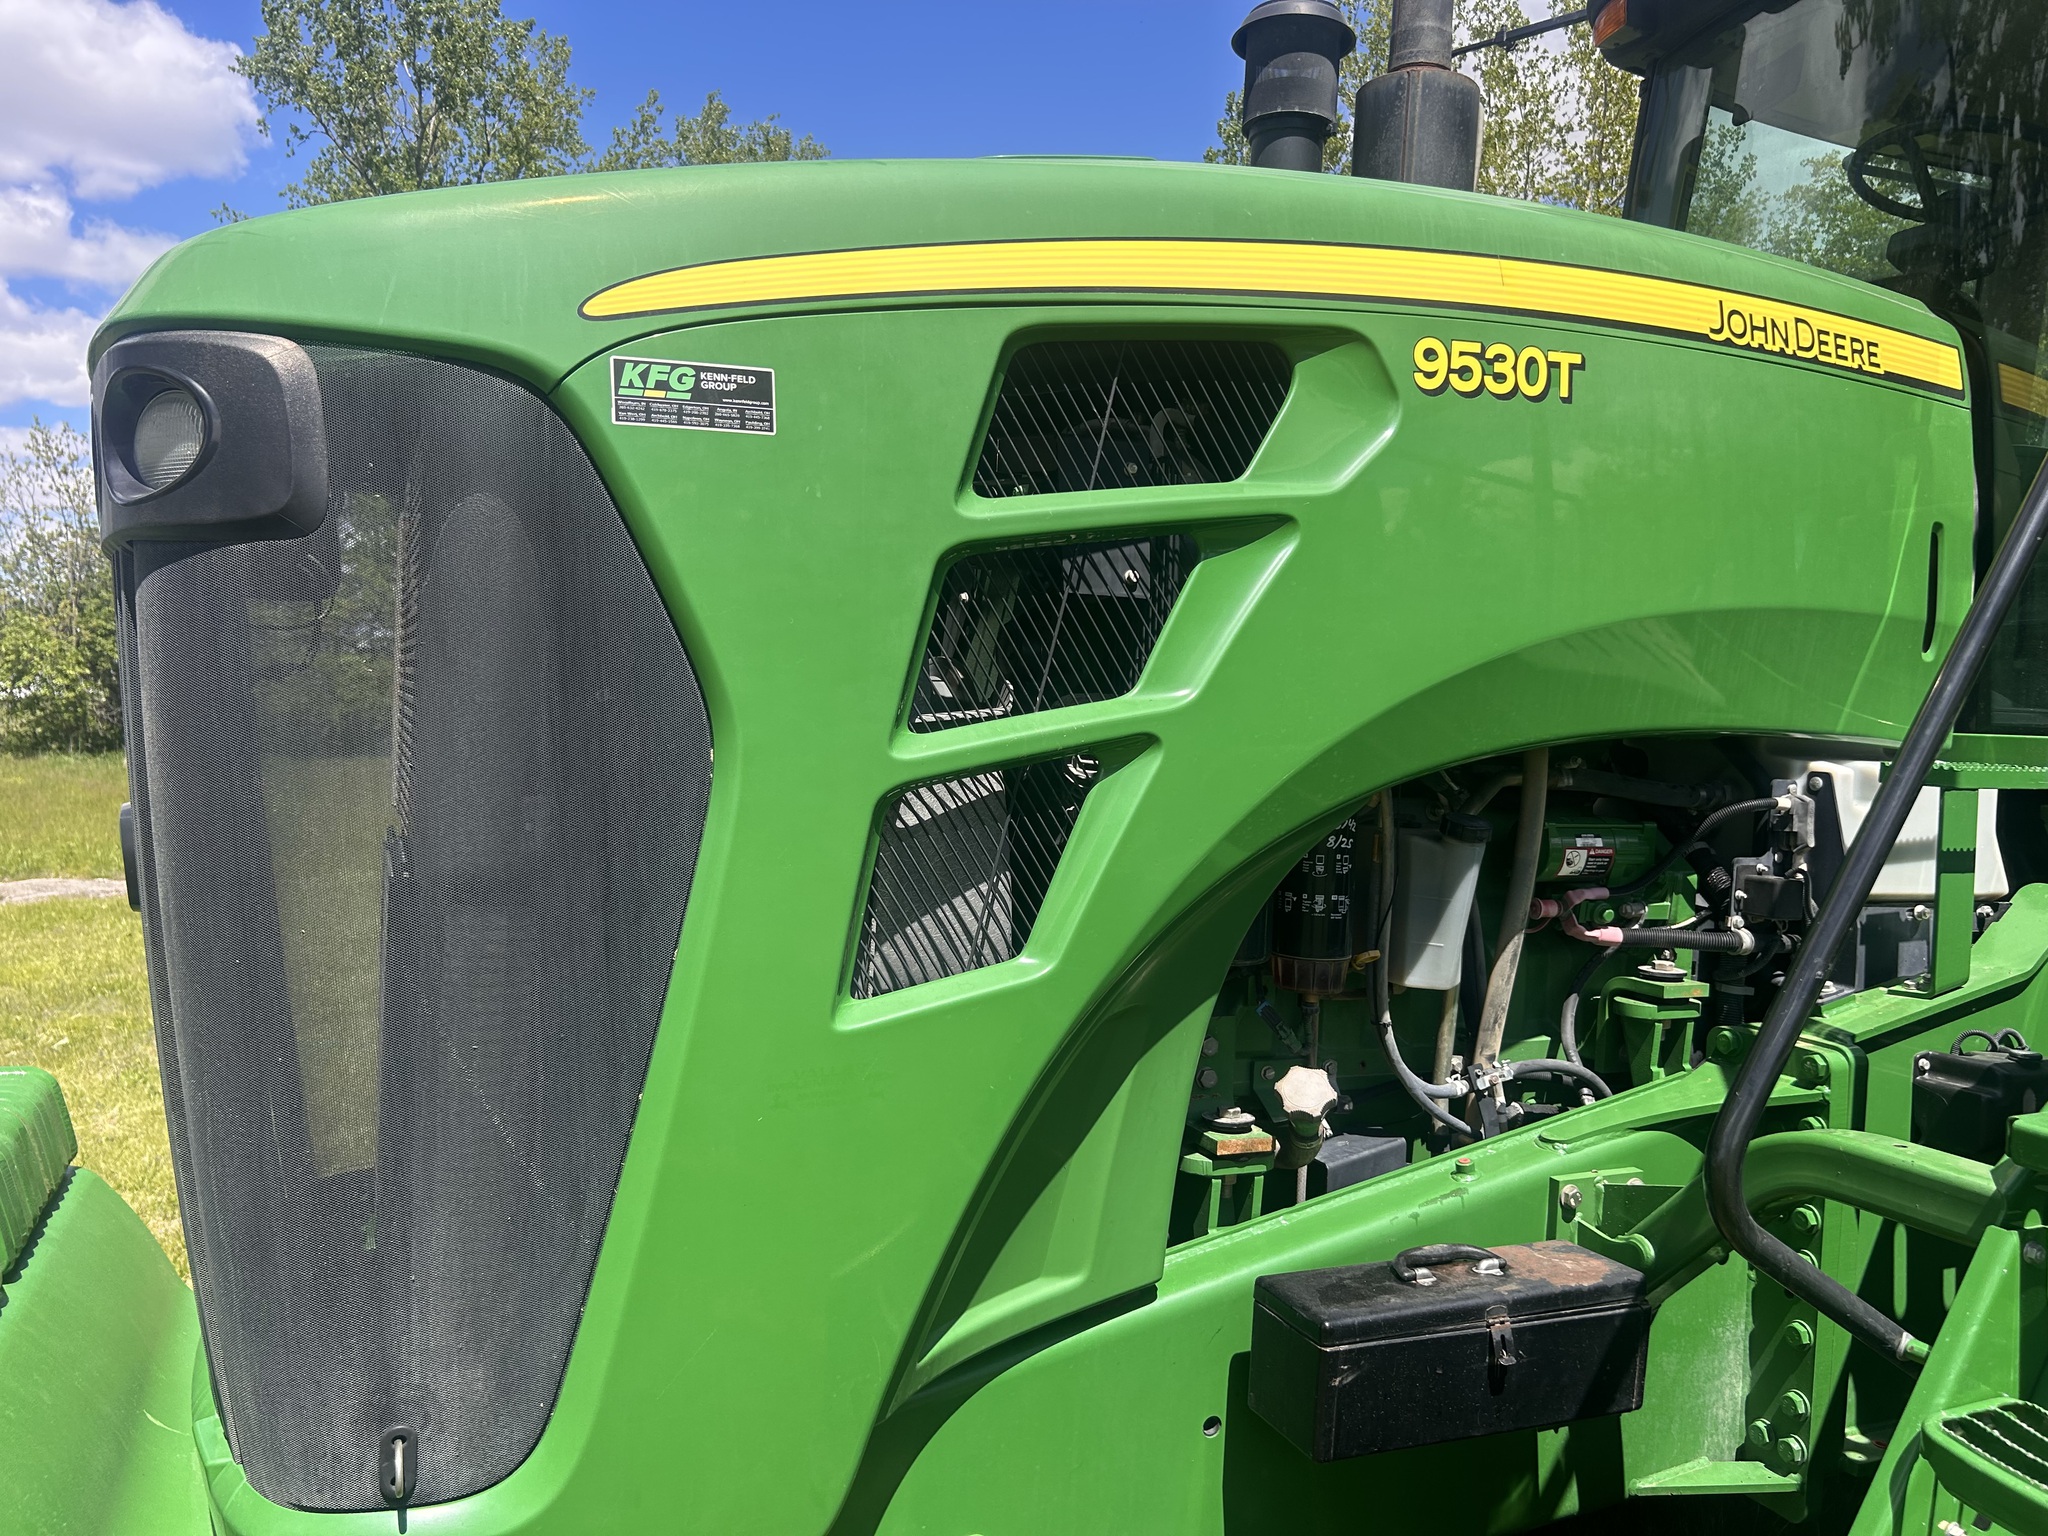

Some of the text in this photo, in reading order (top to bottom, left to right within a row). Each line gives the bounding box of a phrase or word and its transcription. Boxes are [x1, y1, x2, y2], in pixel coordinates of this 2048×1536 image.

[1708, 300, 1882, 371] JOHN DEERE
[619, 362, 696, 391] KFG
[700, 371, 757, 384] KENN-FELD
[1413, 336, 1583, 402] 9530T
[700, 380, 737, 391] GROUP
[1326, 834, 1354, 849] 8/25
